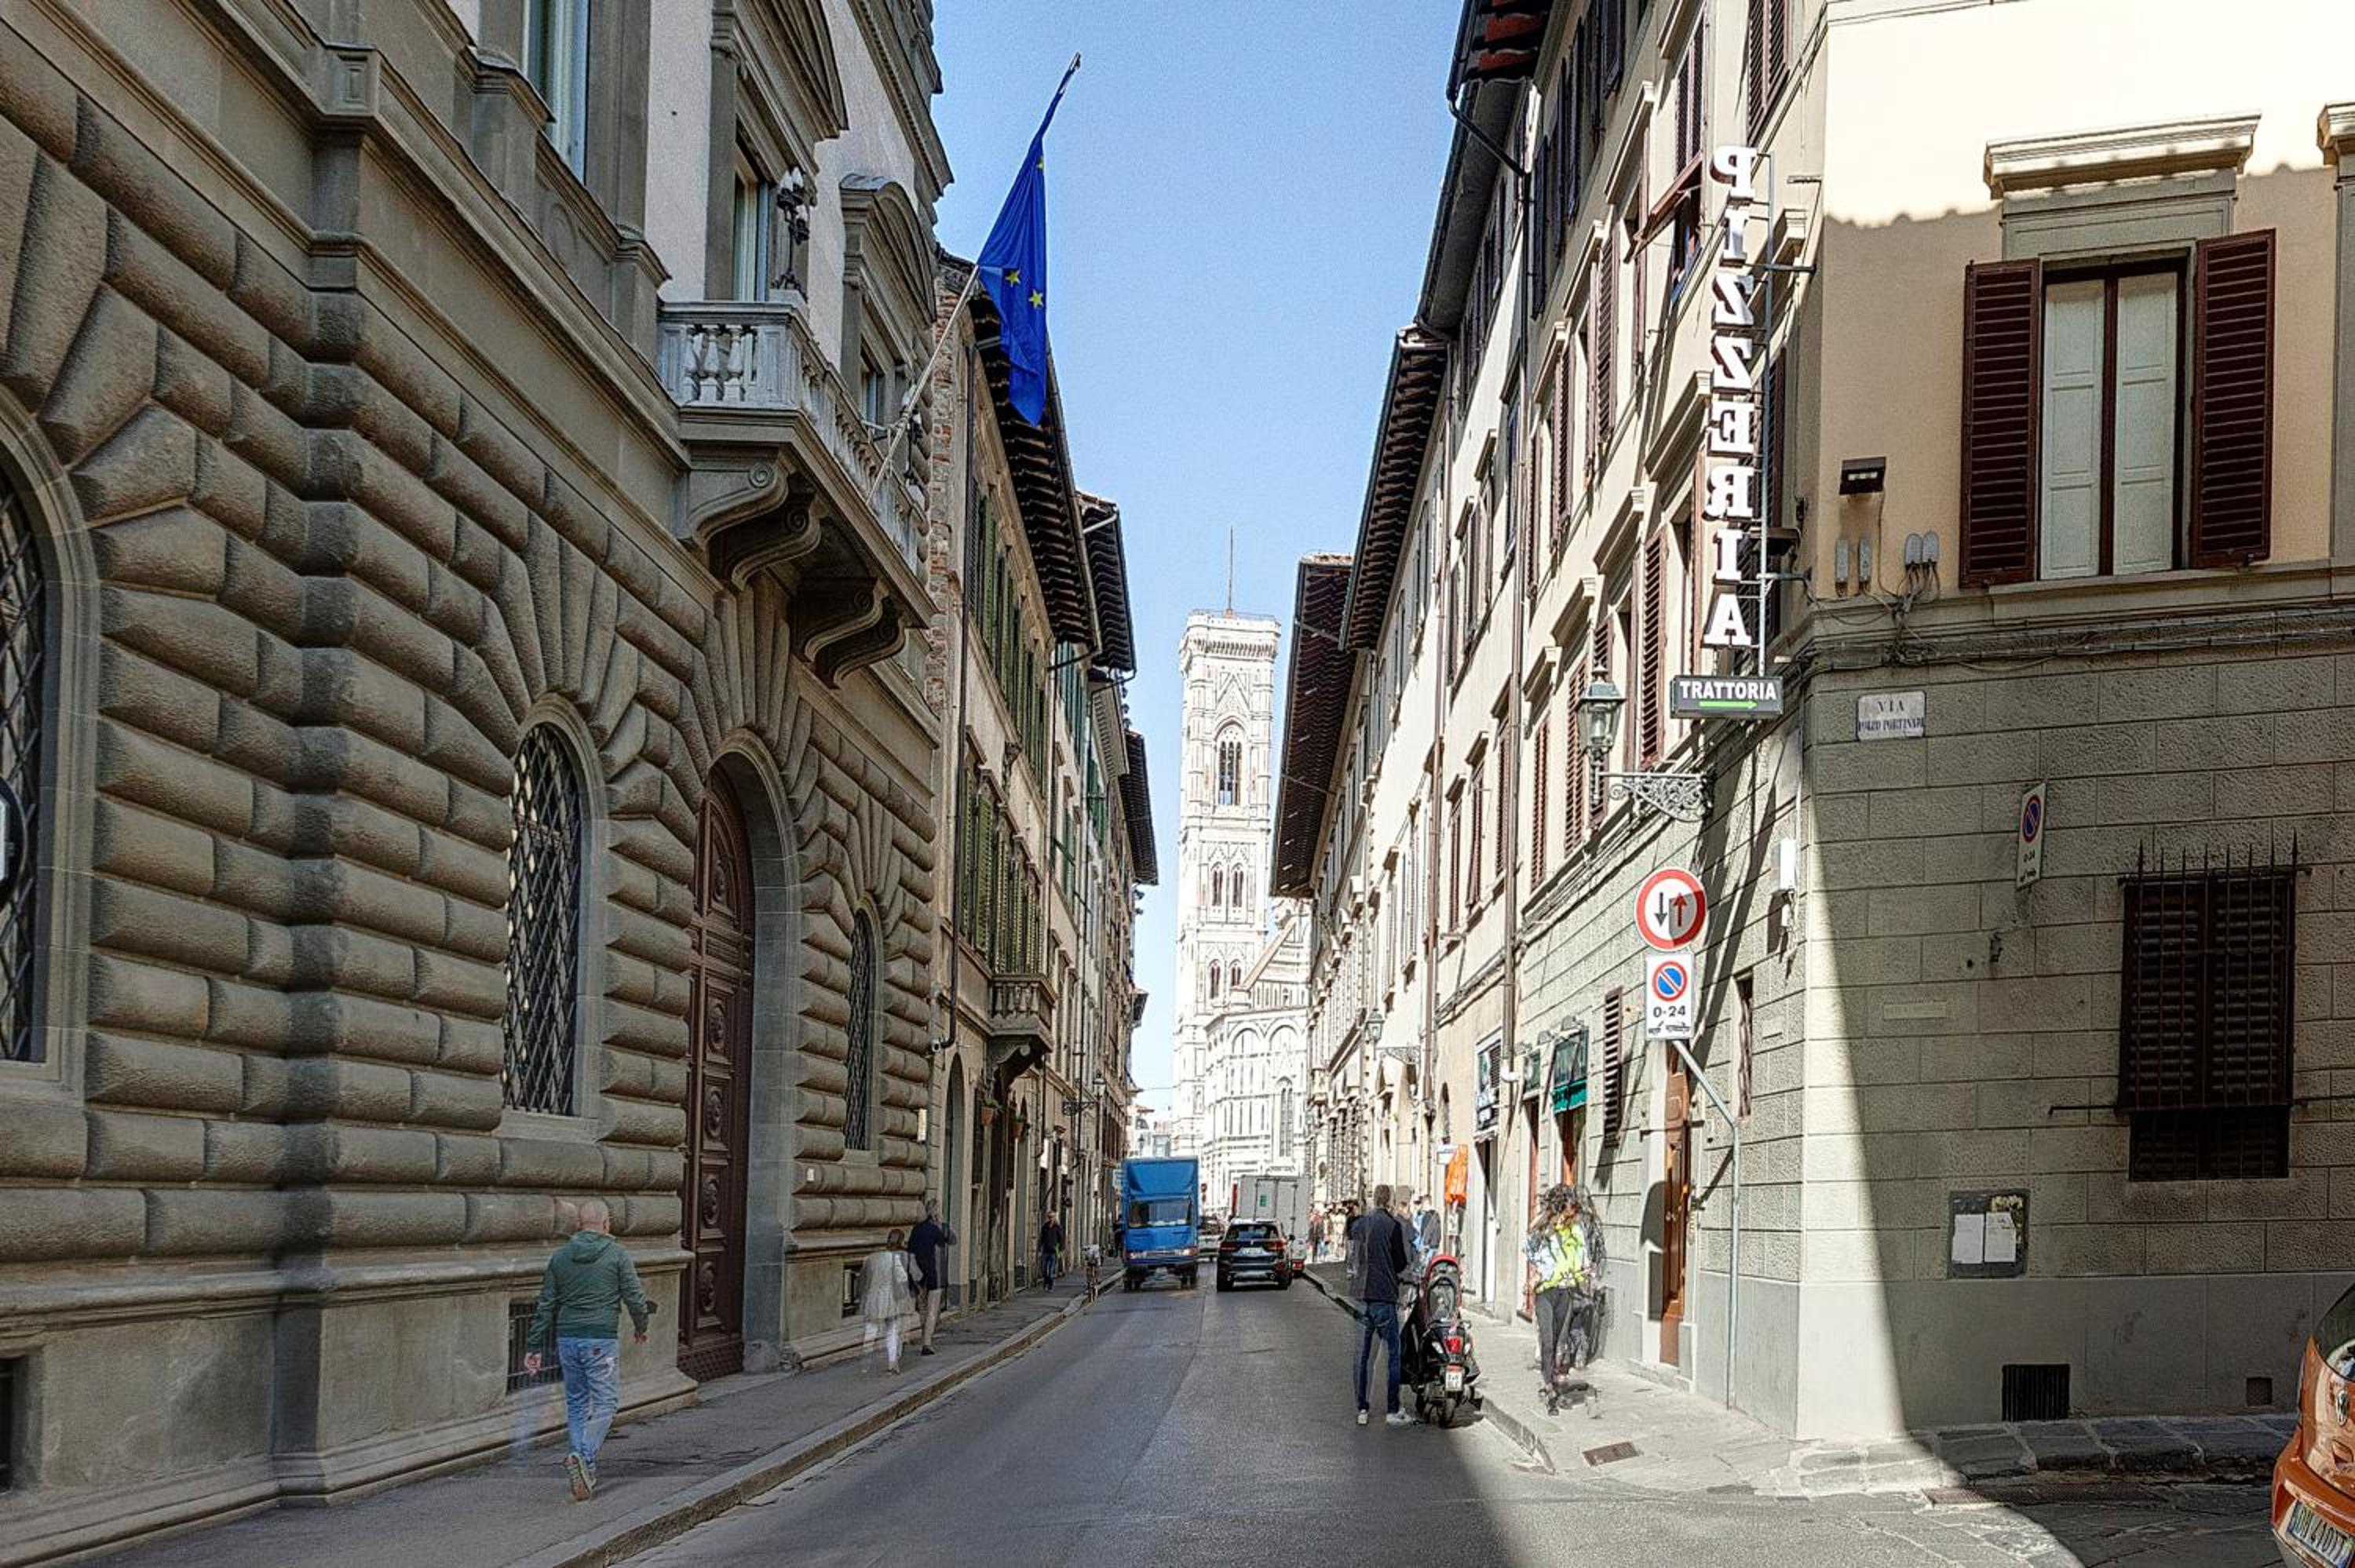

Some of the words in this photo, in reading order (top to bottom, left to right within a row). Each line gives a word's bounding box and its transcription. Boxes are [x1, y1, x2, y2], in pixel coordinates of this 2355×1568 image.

[1680, 680, 1776, 700] TRATTORIA
[1877, 699, 1904, 713] VIA
[1652, 1005, 1686, 1018] 0-24
